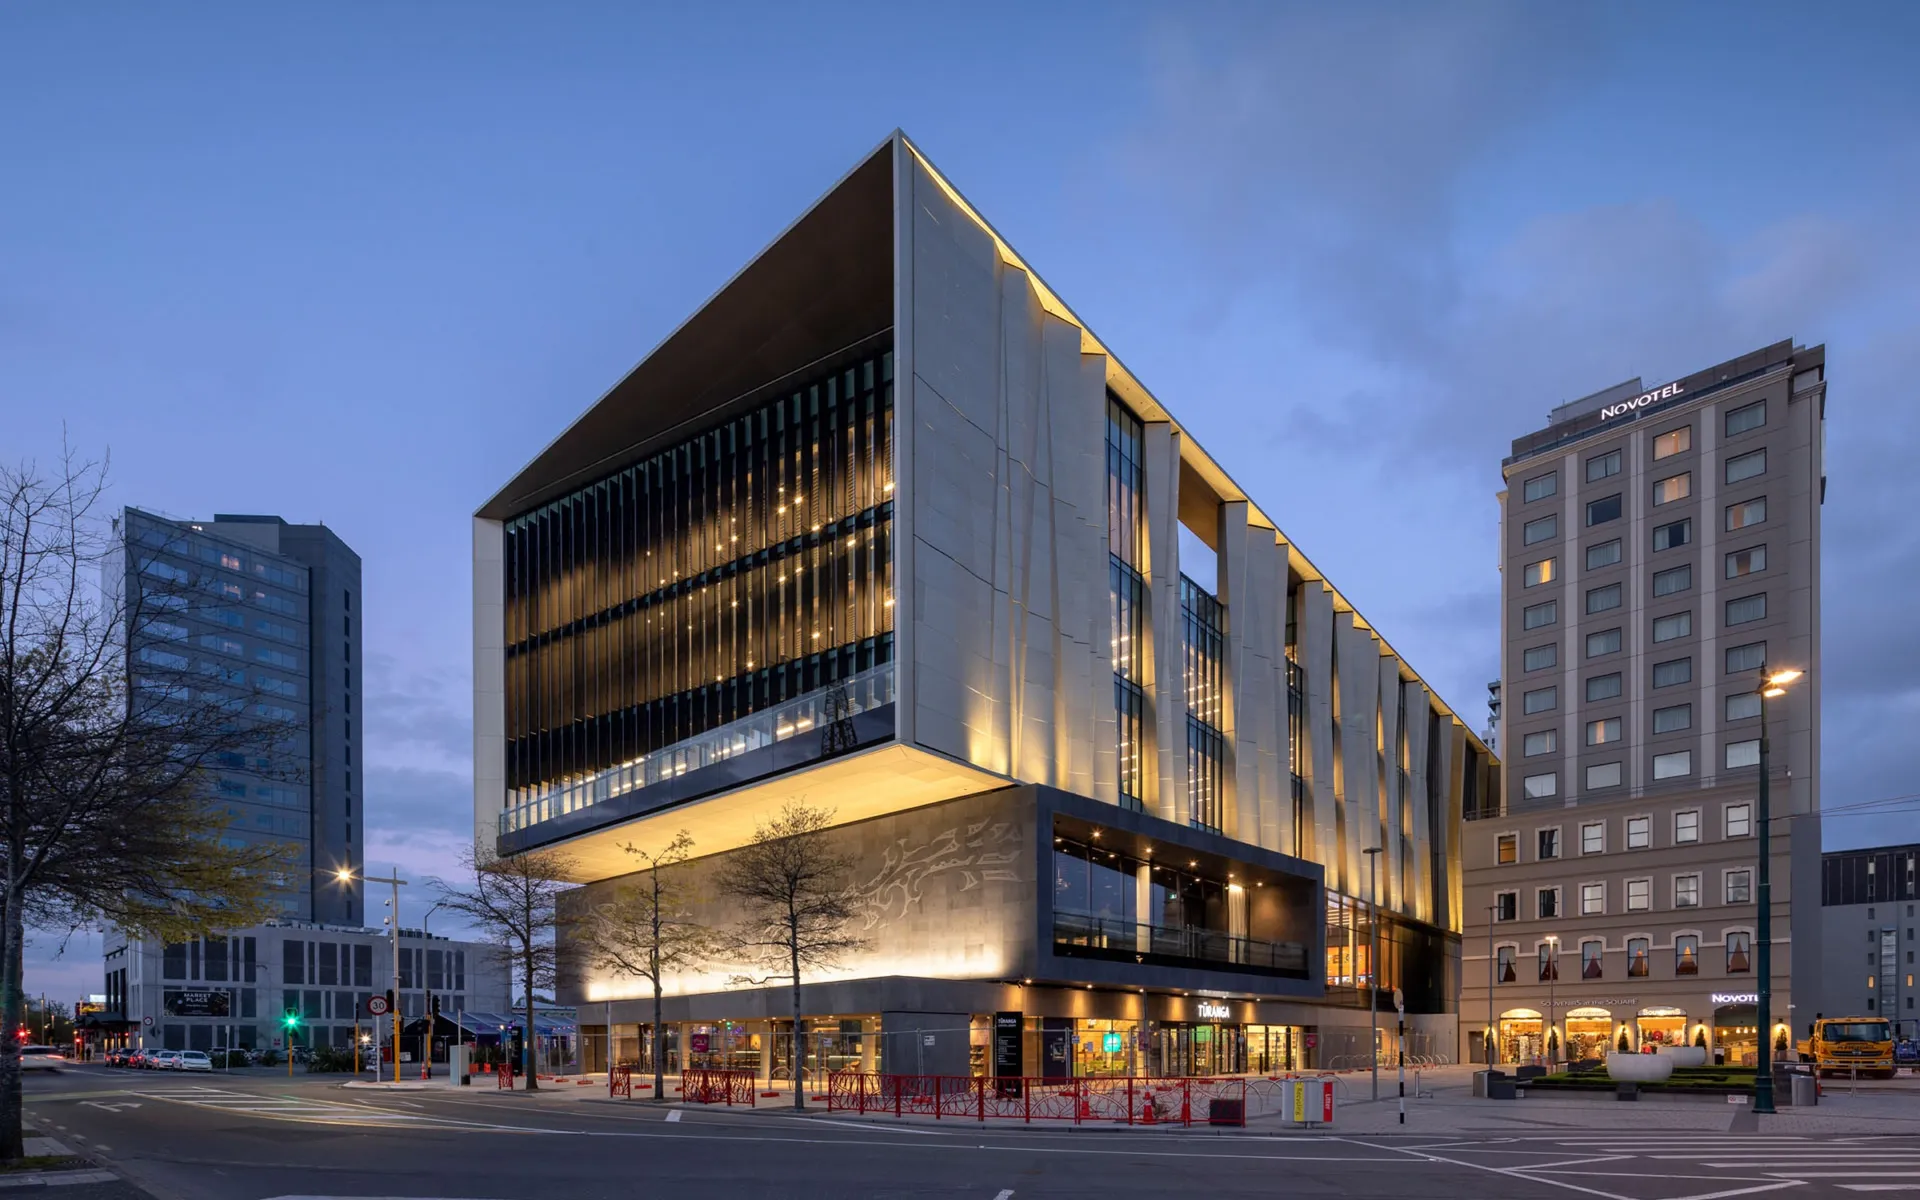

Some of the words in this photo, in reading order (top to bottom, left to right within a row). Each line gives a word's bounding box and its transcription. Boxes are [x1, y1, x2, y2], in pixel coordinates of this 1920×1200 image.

[1601, 383, 1684, 420] NOVOTEL
[1712, 994, 1758, 1002] NOVOT
[372, 1001, 385, 1010] 30
